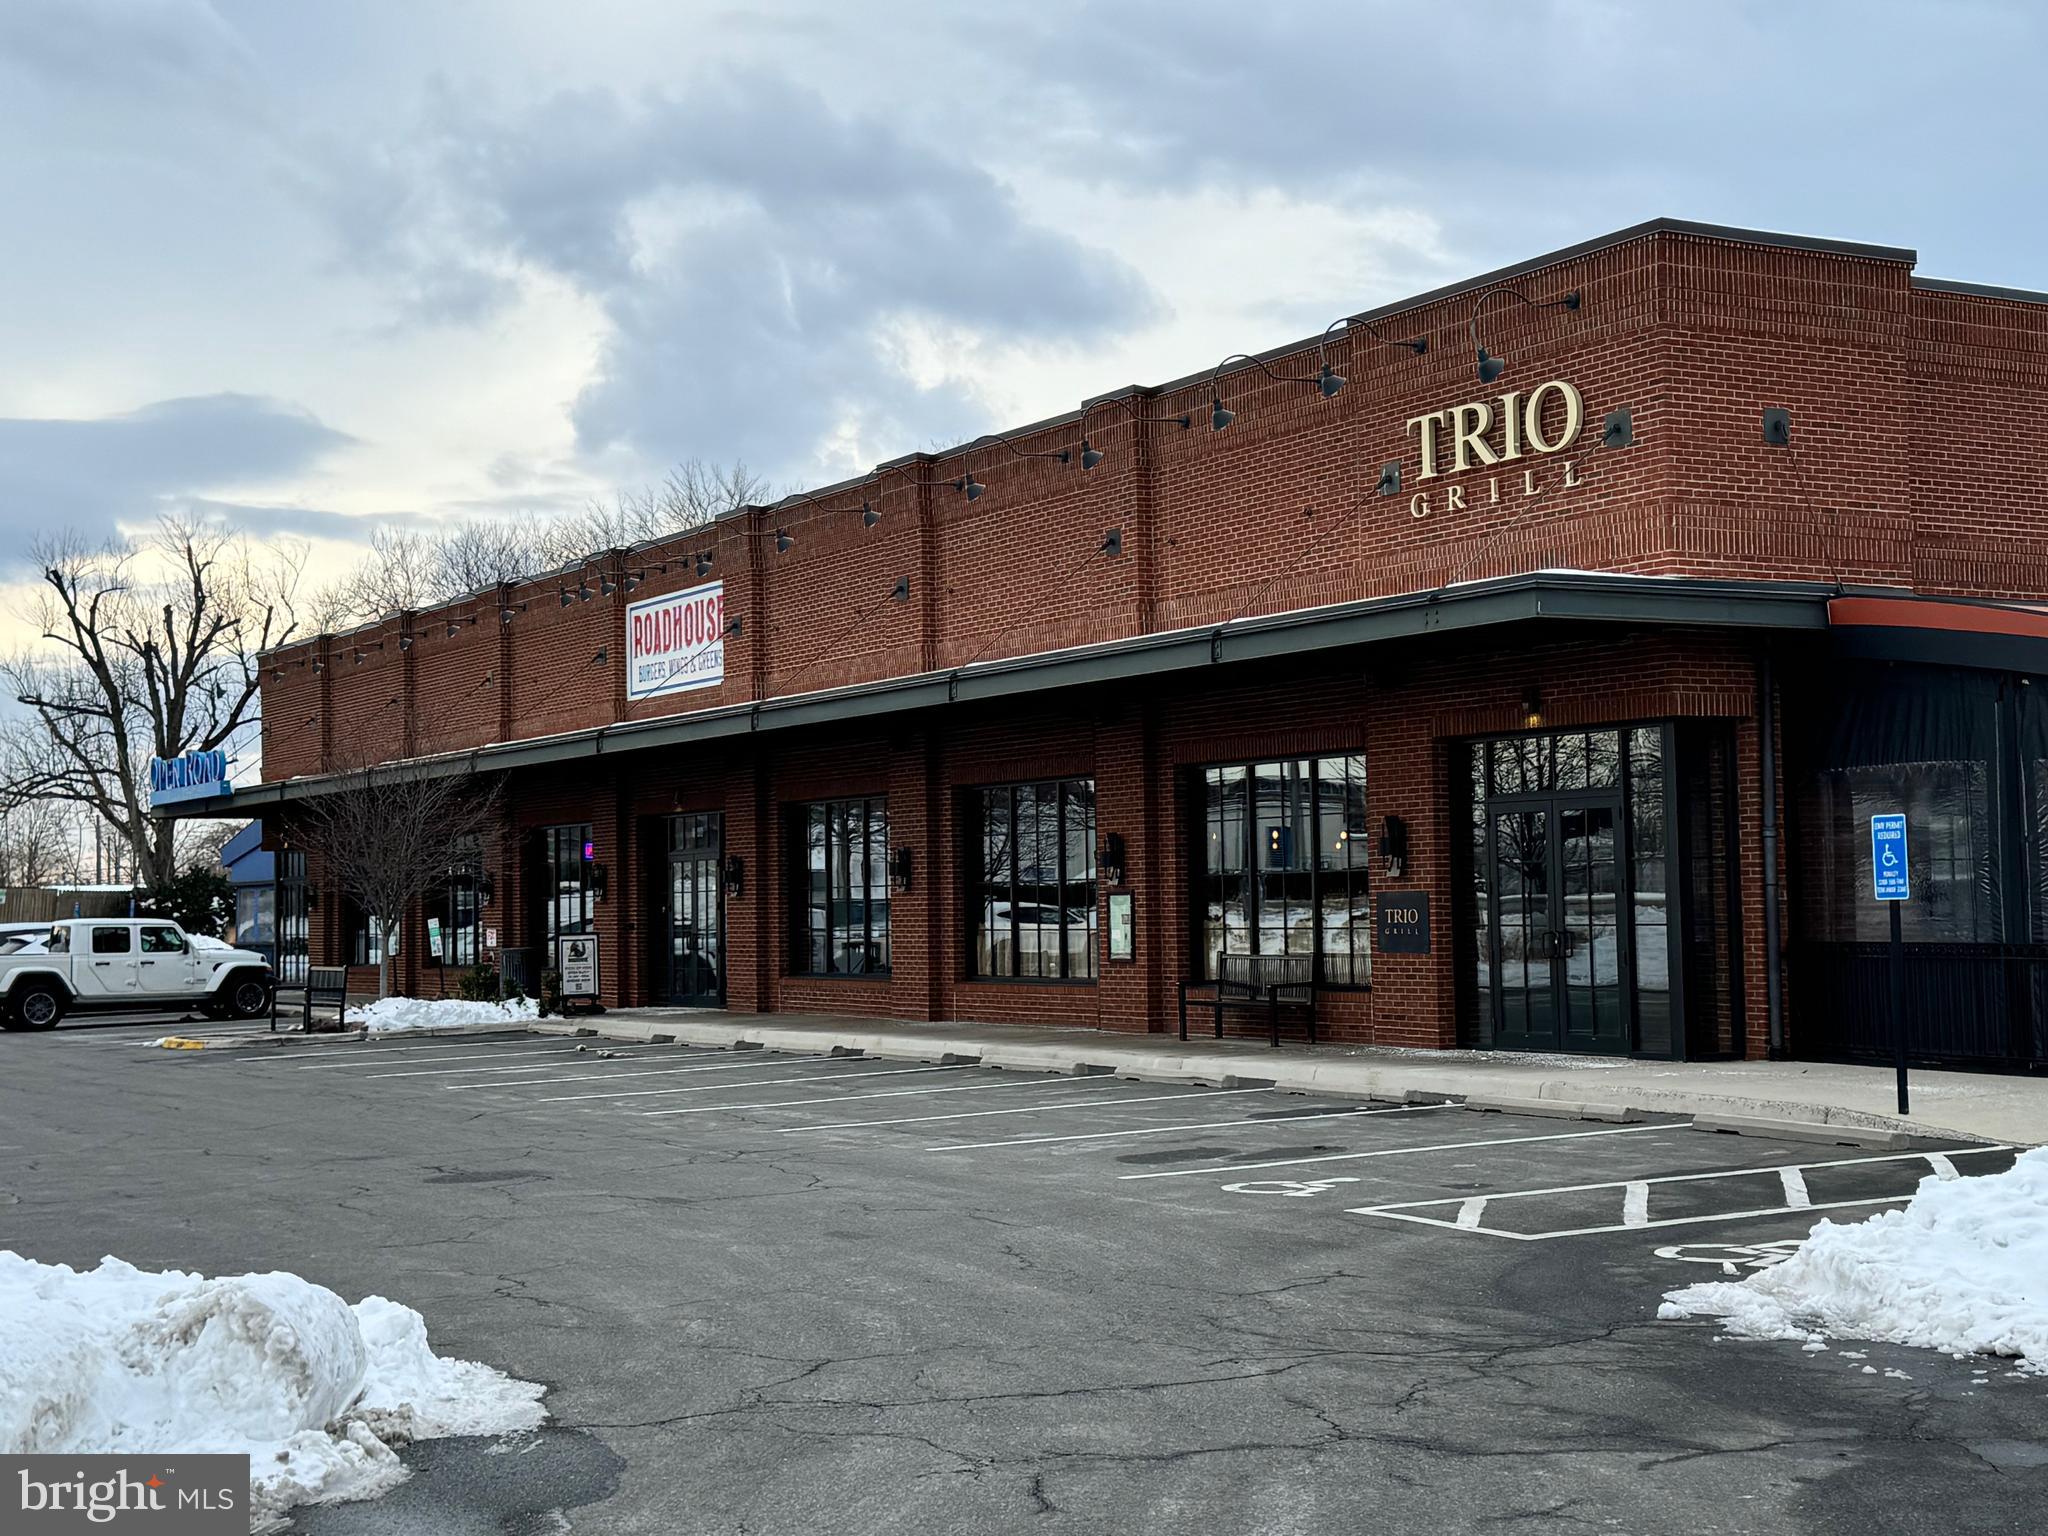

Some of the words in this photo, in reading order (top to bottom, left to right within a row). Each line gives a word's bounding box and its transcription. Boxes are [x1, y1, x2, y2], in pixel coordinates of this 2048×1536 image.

[1406, 380, 1583, 481] TRIO
[1410, 461, 1584, 519] GRILL
[634, 595, 725, 659] ROADHOUSE
[151, 758, 180, 792] OPEN
[185, 751, 222, 787] ROAD
[1384, 927, 1419, 935] GRILL
[1385, 908, 1419, 924] TRIO
